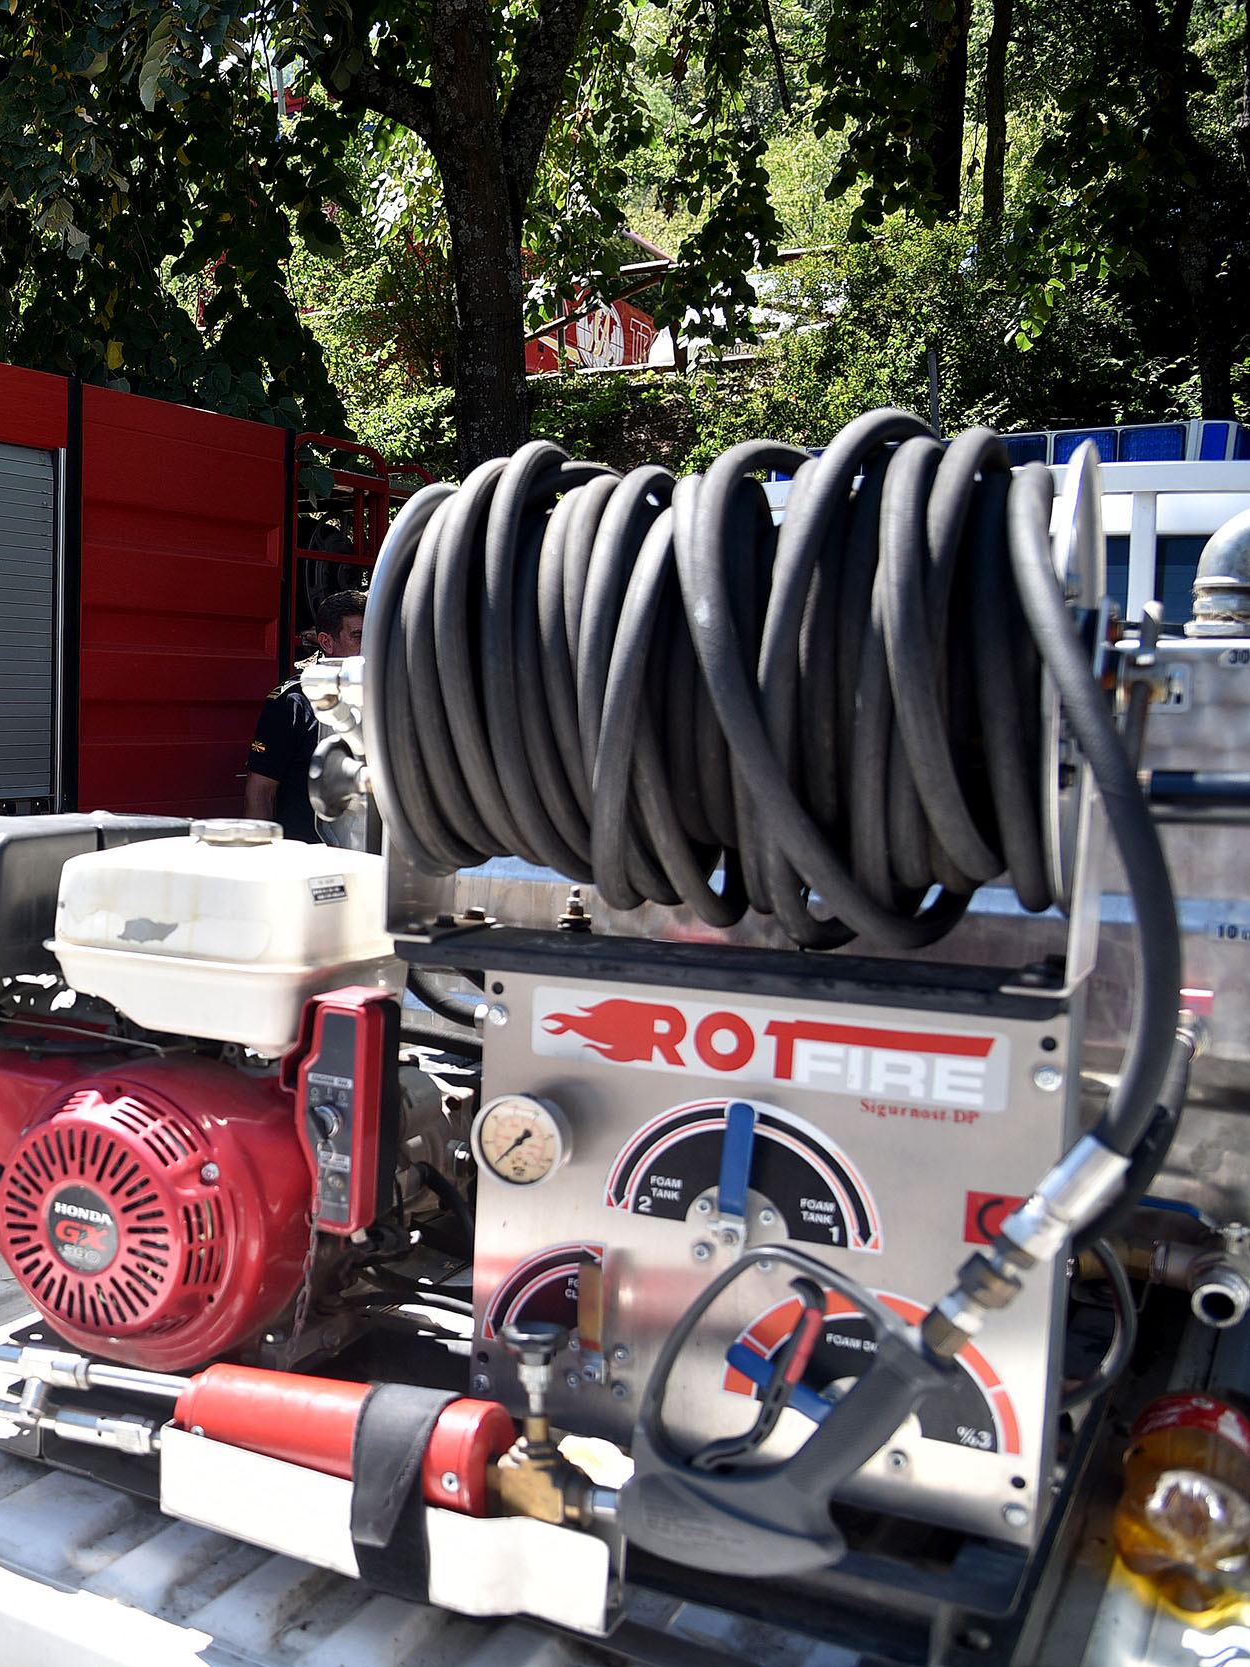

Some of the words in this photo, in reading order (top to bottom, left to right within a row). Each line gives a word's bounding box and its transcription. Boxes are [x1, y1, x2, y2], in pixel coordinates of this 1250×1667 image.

[649, 1175, 683, 1190] FOAM
[650, 1187, 680, 1201] TANK
[637, 1196, 653, 1213] 2
[799, 1198, 836, 1213] FOAM
[54, 1201, 113, 1227] HONDA
[800, 1210, 834, 1225] TANK
[54, 1219, 109, 1251] GX
[828, 1226, 841, 1244] 1
[825, 1333, 862, 1351] FOAM
[956, 1425, 992, 1449] %3
